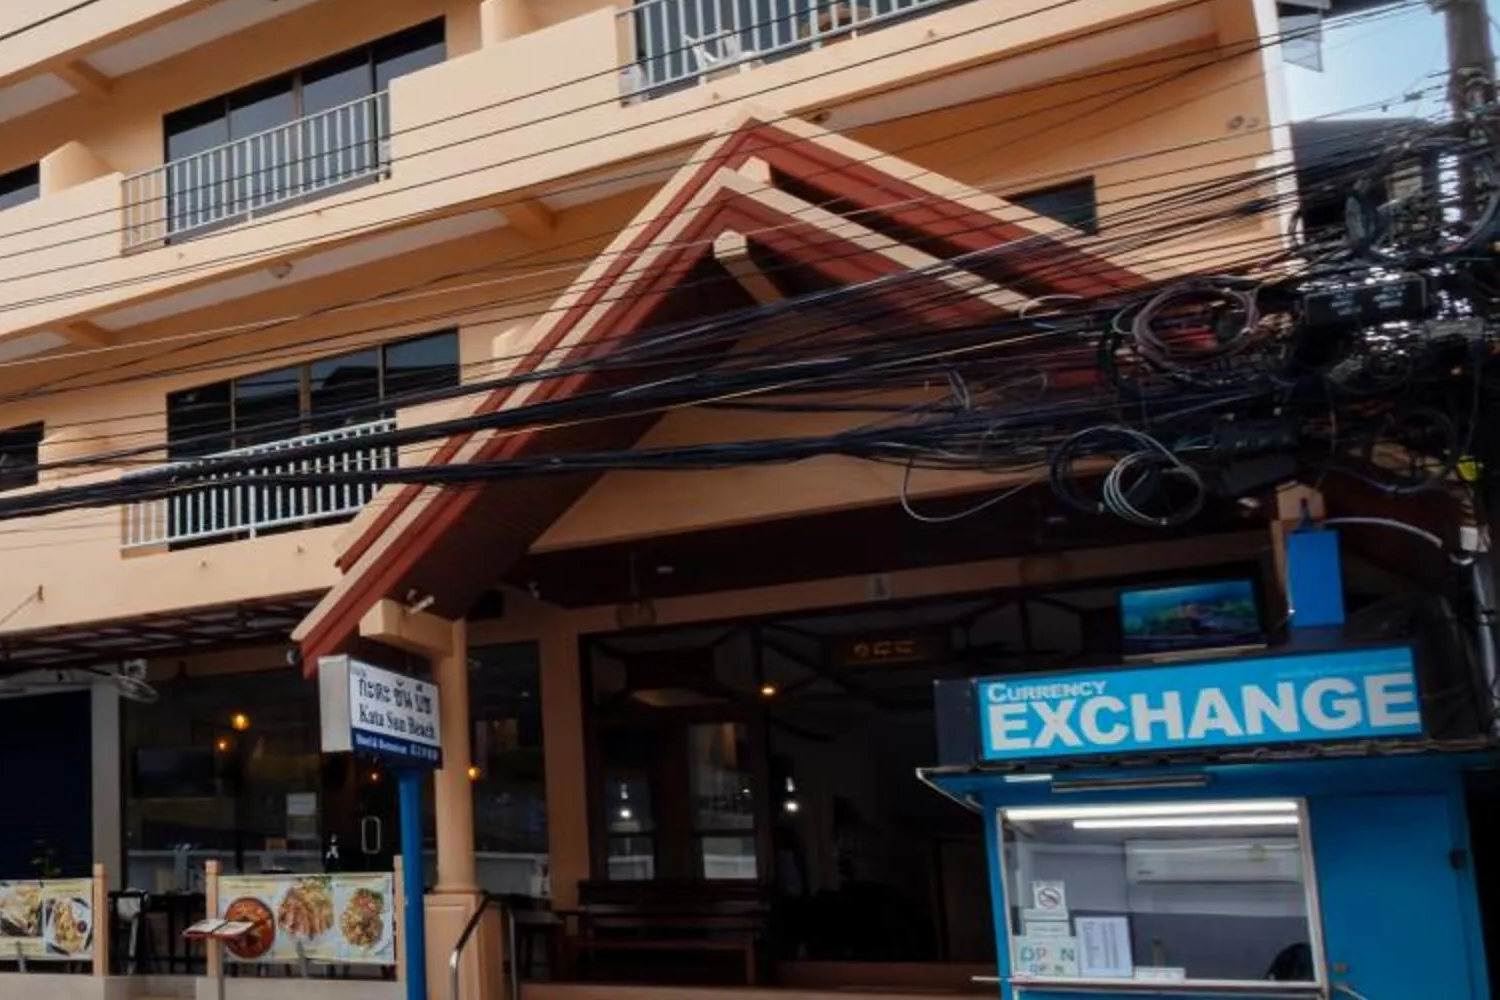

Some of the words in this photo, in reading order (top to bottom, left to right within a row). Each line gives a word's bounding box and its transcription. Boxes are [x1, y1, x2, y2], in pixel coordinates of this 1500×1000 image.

[987, 680, 1107, 702] CURRENCY
[359, 703, 384, 727] Kata
[386, 710, 406, 732] Sun
[407, 716, 436, 739] Beach
[989, 674, 1420, 750] EXCHANGE
[1021, 946, 1075, 961] OPN
